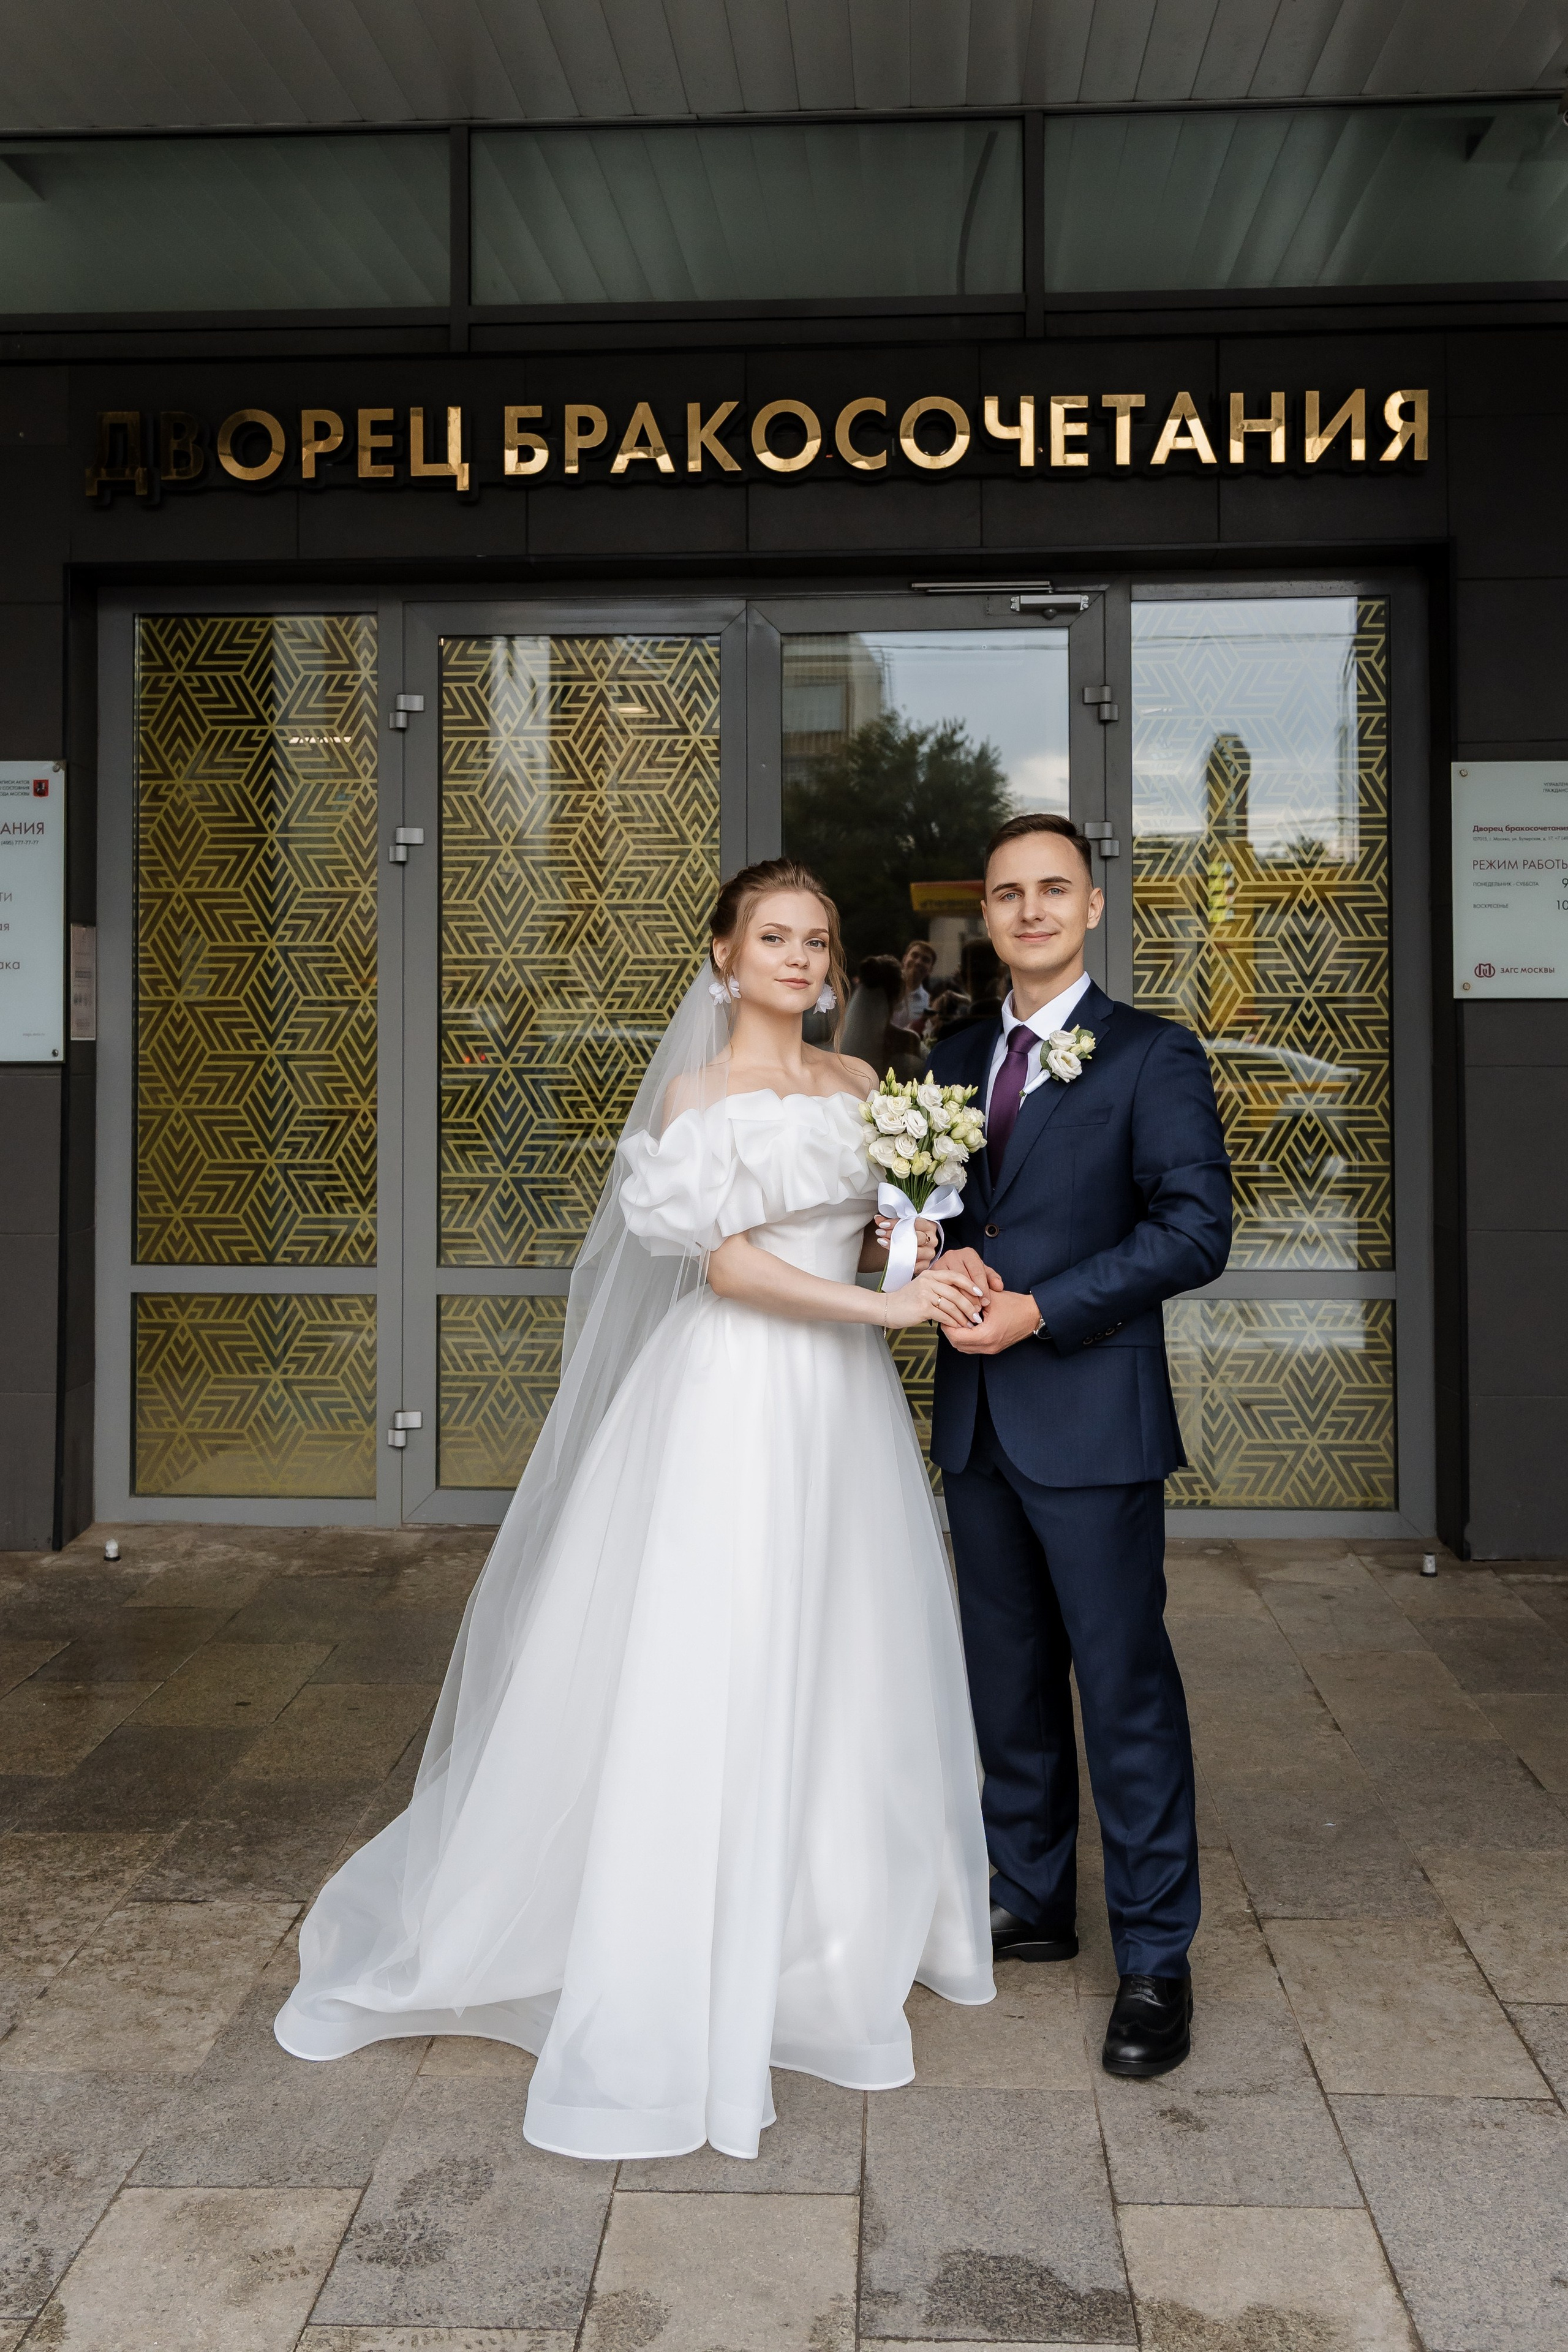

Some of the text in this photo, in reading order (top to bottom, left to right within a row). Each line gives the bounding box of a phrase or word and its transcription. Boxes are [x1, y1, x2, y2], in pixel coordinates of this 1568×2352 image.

[85, 388, 1429, 496] ДВОРЕЦ БРАКОСОЧЕТАНИЯ
[1472, 859, 1518, 870] РЕЖИМ
